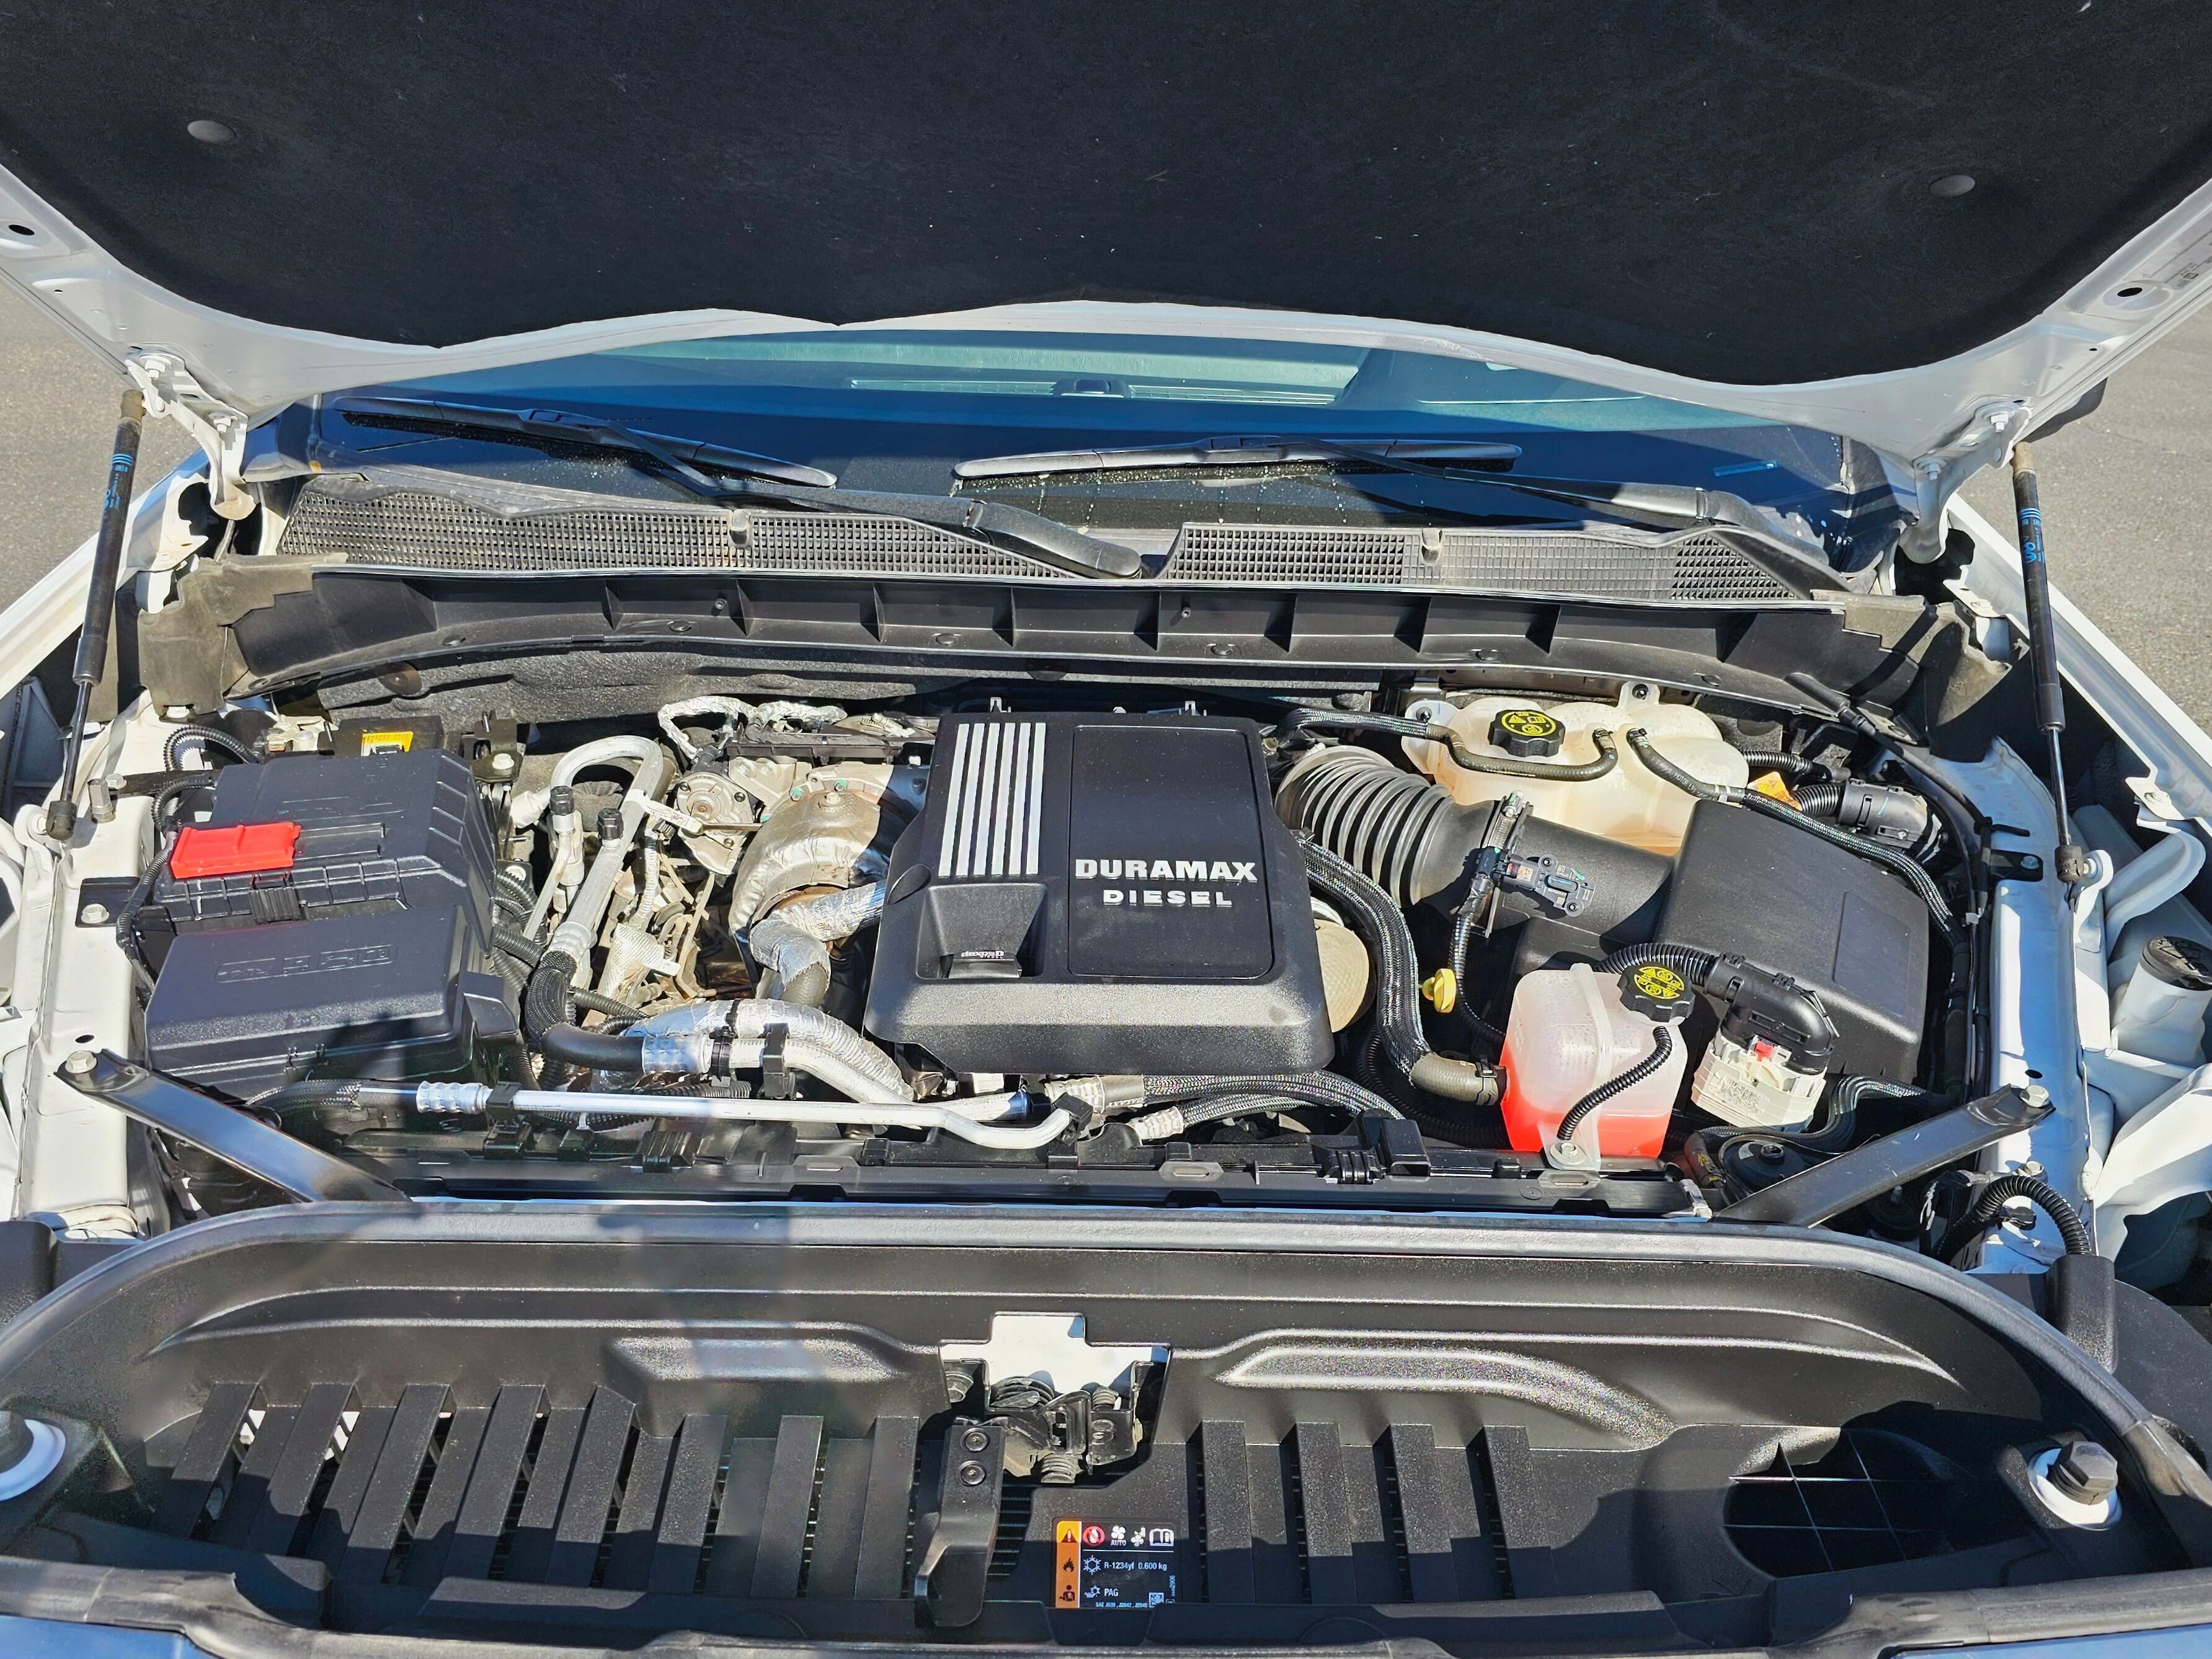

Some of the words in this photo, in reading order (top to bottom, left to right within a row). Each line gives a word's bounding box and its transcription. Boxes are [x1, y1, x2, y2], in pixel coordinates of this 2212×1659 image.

[1075, 859, 1258, 883] DURAMAX
[1103, 889, 1232, 907] DIESEL
[1104, 1562, 1134, 1570] R-1234yf
[1158, 1562, 1167, 1571] kg
[1104, 1588, 1119, 1596] PAG
